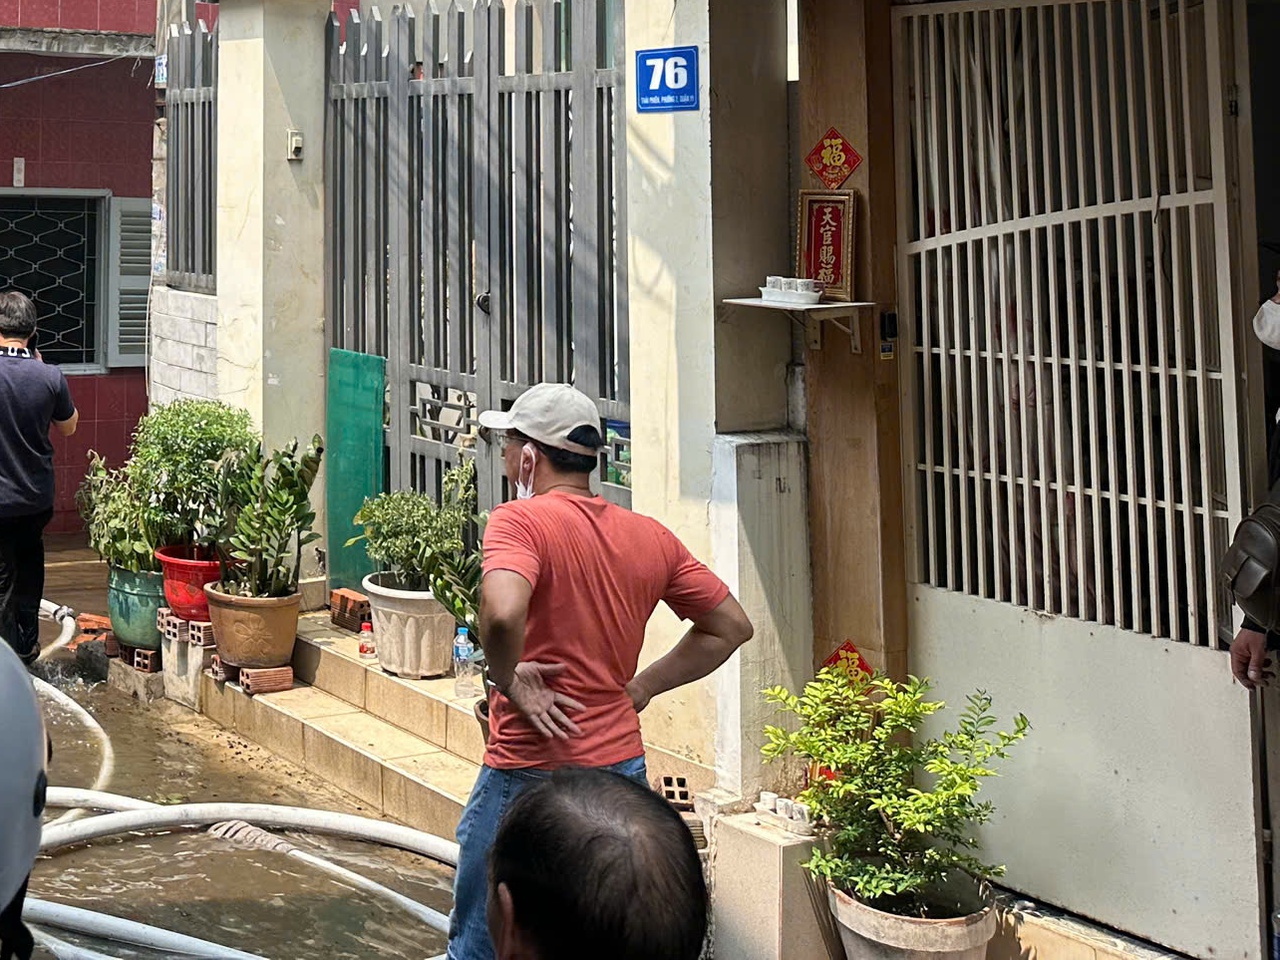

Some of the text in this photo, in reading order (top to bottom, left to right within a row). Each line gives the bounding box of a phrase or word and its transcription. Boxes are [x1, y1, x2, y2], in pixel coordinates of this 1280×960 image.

[645, 56, 688, 91] 76
[821, 137, 846, 167] 福
[816, 207, 838, 284] 天官賜福
